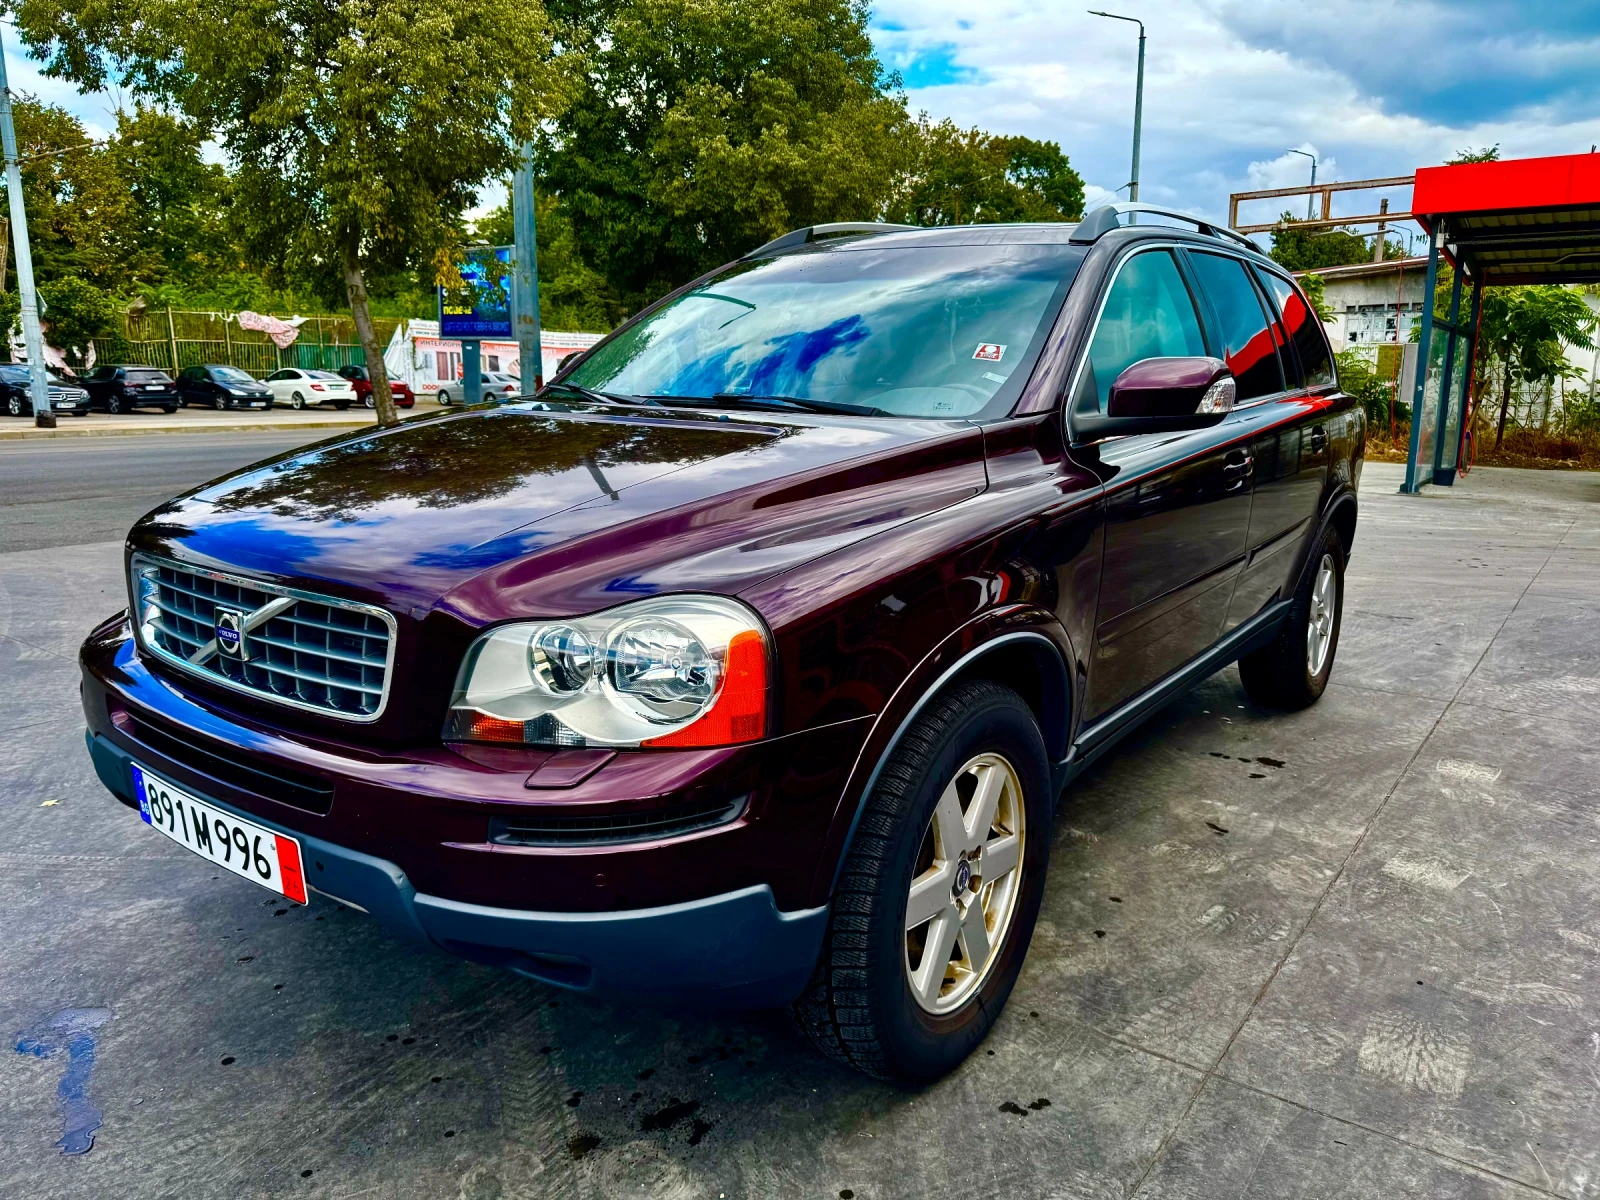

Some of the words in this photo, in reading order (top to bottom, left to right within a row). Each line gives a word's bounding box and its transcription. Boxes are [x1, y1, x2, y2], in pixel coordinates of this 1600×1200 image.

[218, 629, 238, 640] VOLVO
[139, 799, 150, 815] BG
[148, 783, 271, 880] 891M996
